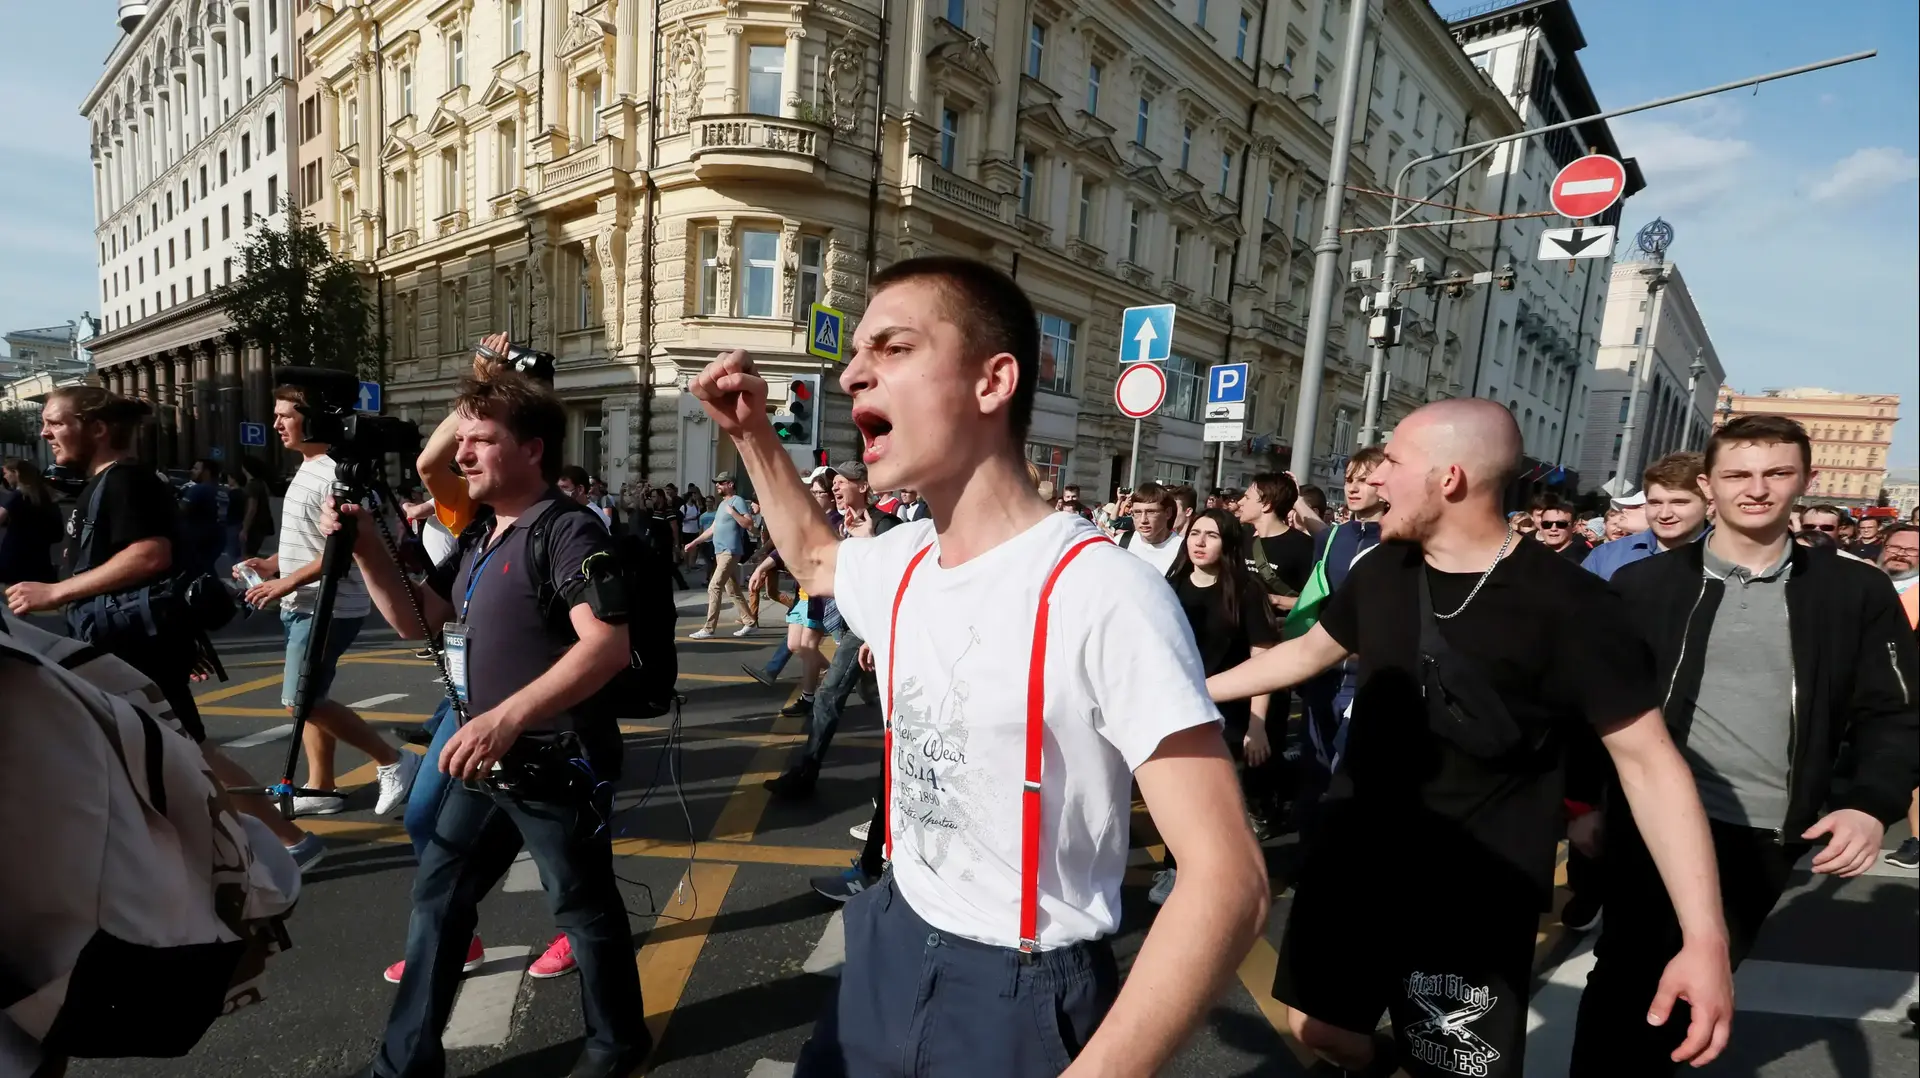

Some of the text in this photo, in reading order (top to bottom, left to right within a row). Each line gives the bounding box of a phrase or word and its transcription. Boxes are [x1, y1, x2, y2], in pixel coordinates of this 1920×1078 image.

[1217, 369, 1239, 398] P
[248, 425, 261, 443] P
[446, 636, 464, 647] PRESS
[923, 728, 967, 765] Wear
[918, 790, 940, 807] 1890
[846, 880, 865, 894] N
[1411, 1033, 1488, 1077] RULES
